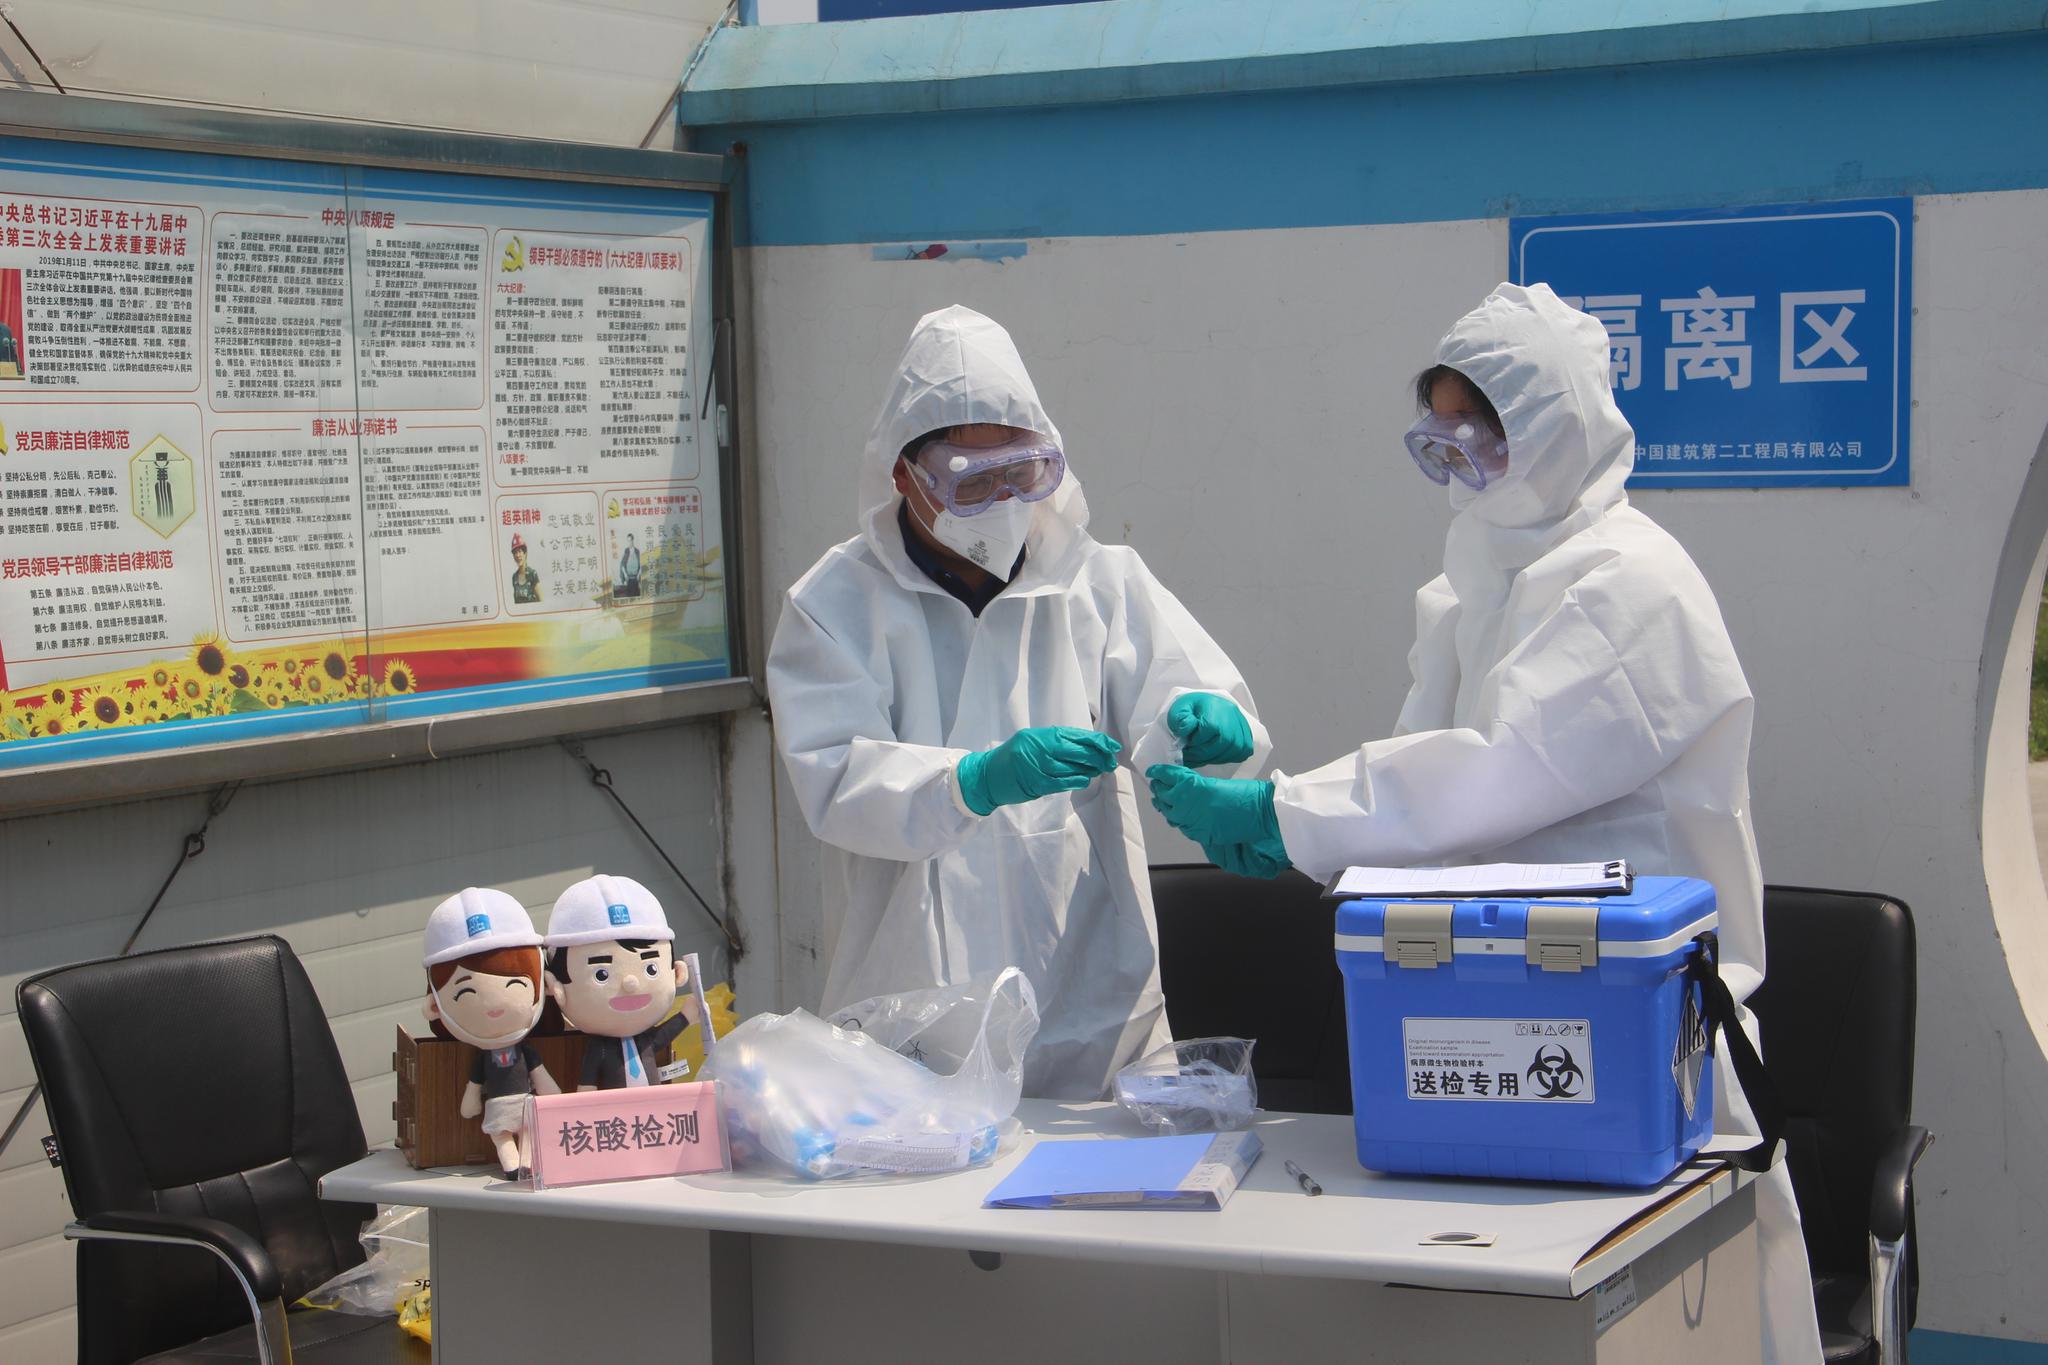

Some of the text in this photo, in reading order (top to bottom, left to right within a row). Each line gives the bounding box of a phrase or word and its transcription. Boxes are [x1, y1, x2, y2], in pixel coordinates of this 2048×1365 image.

[0, 203, 187, 233] 央总书记习近平在十九届中
[321, 208, 396, 229] 中央八项规定
[312, 418, 398, 436] 廉洁从业承诺书
[16, 430, 130, 451] 党员廉洁自律规范
[1634, 441, 1862, 460] 中国建筑第二工程局有限公司
[502, 508, 541, 526] 超英精神
[547, 512, 595, 528] 忠诚敬业
[3, 550, 173, 579] 党员领导干部廉洁自律规范
[552, 559, 598, 573] 执纪严明
[30, 587, 53, 599] 第五条
[552, 579, 602, 596] 关爱群众
[33, 603, 55, 617] 第六条
[35, 621, 56, 634] 第七条
[36, 637, 58, 651] 第八条
[1411, 1059, 1484, 1067] 病原微生物检验样本
[1413, 1071, 1518, 1096] 送检专用
[559, 1110, 699, 1156] 核酸检测
